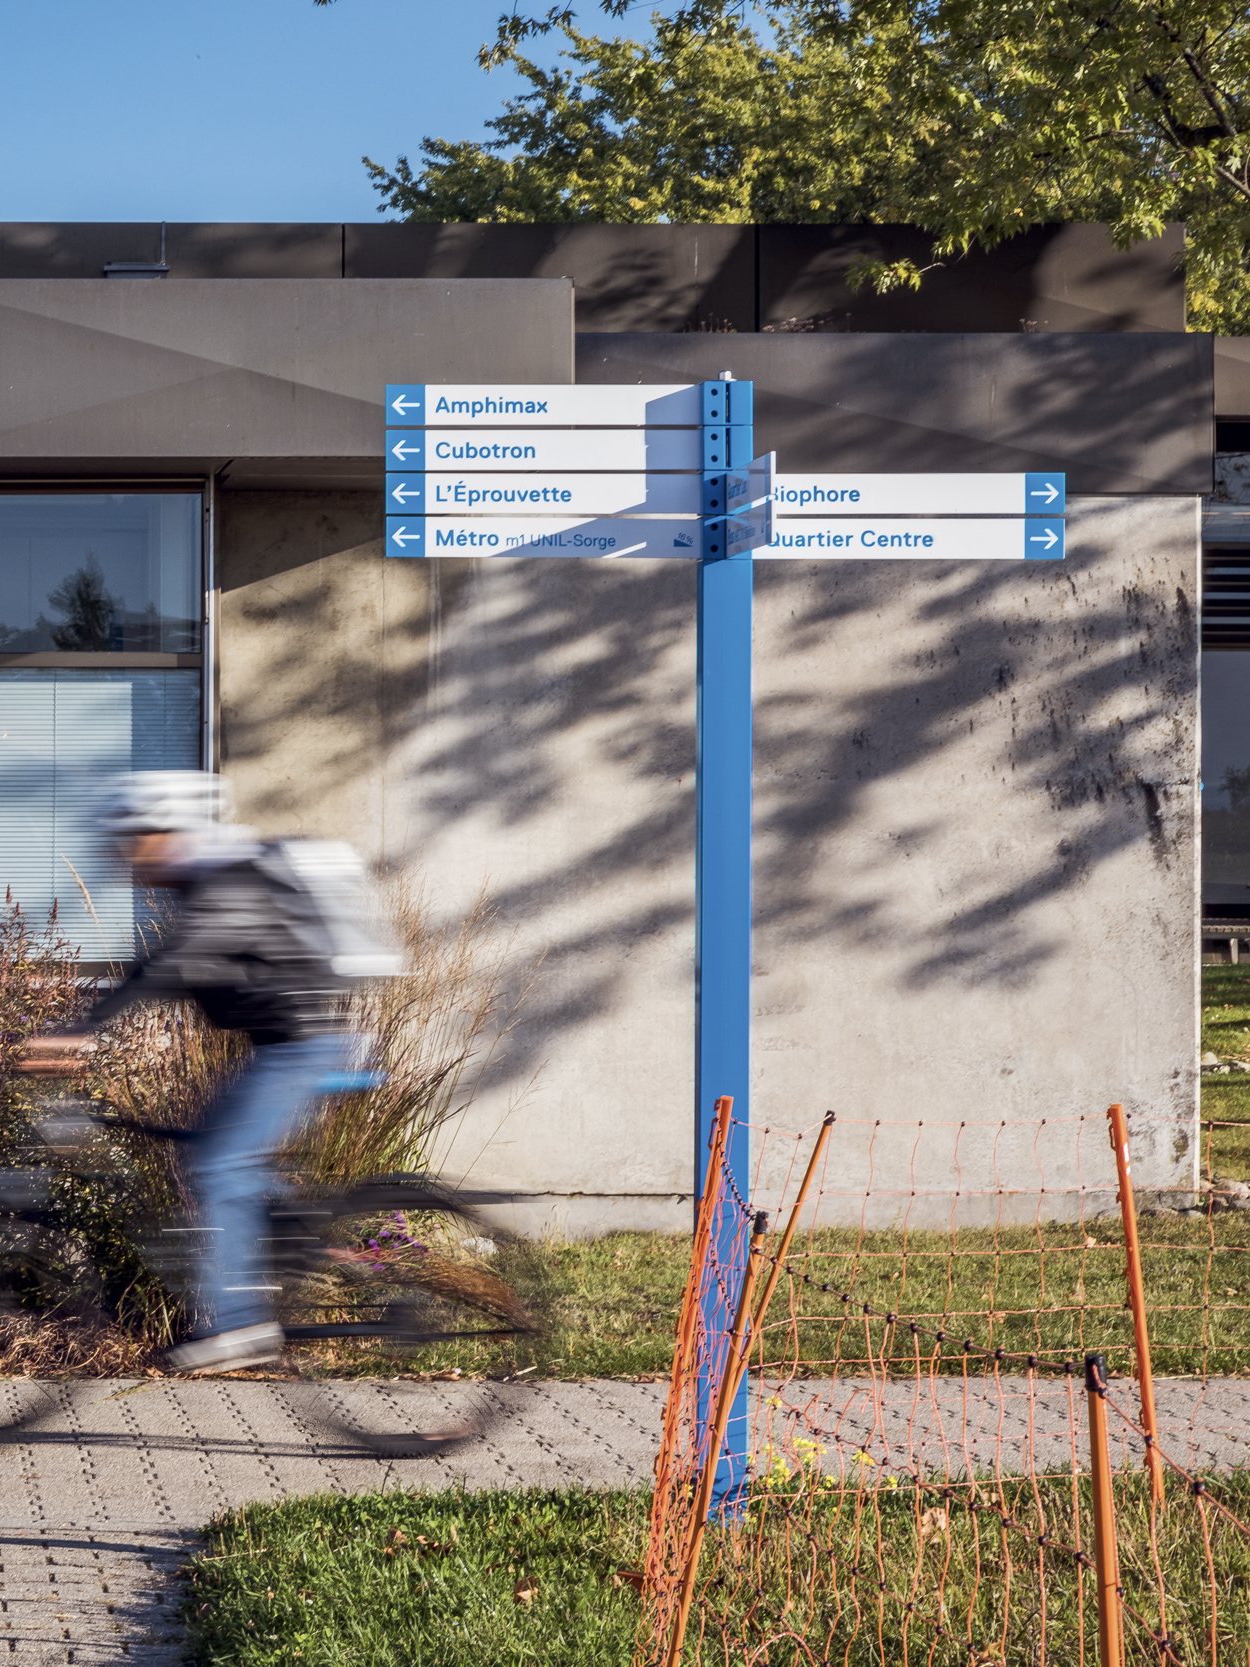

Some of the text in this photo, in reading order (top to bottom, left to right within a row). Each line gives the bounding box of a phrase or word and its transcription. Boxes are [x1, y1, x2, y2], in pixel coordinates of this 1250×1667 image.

[435, 396, 548, 419] Amphimax
[435, 441, 536, 460] Cubotron
[435, 480, 573, 507] L’Éprouvette
[435, 529, 617, 551] Métro m1 UNIL-Sorge
[860, 529, 934, 548] Centre
